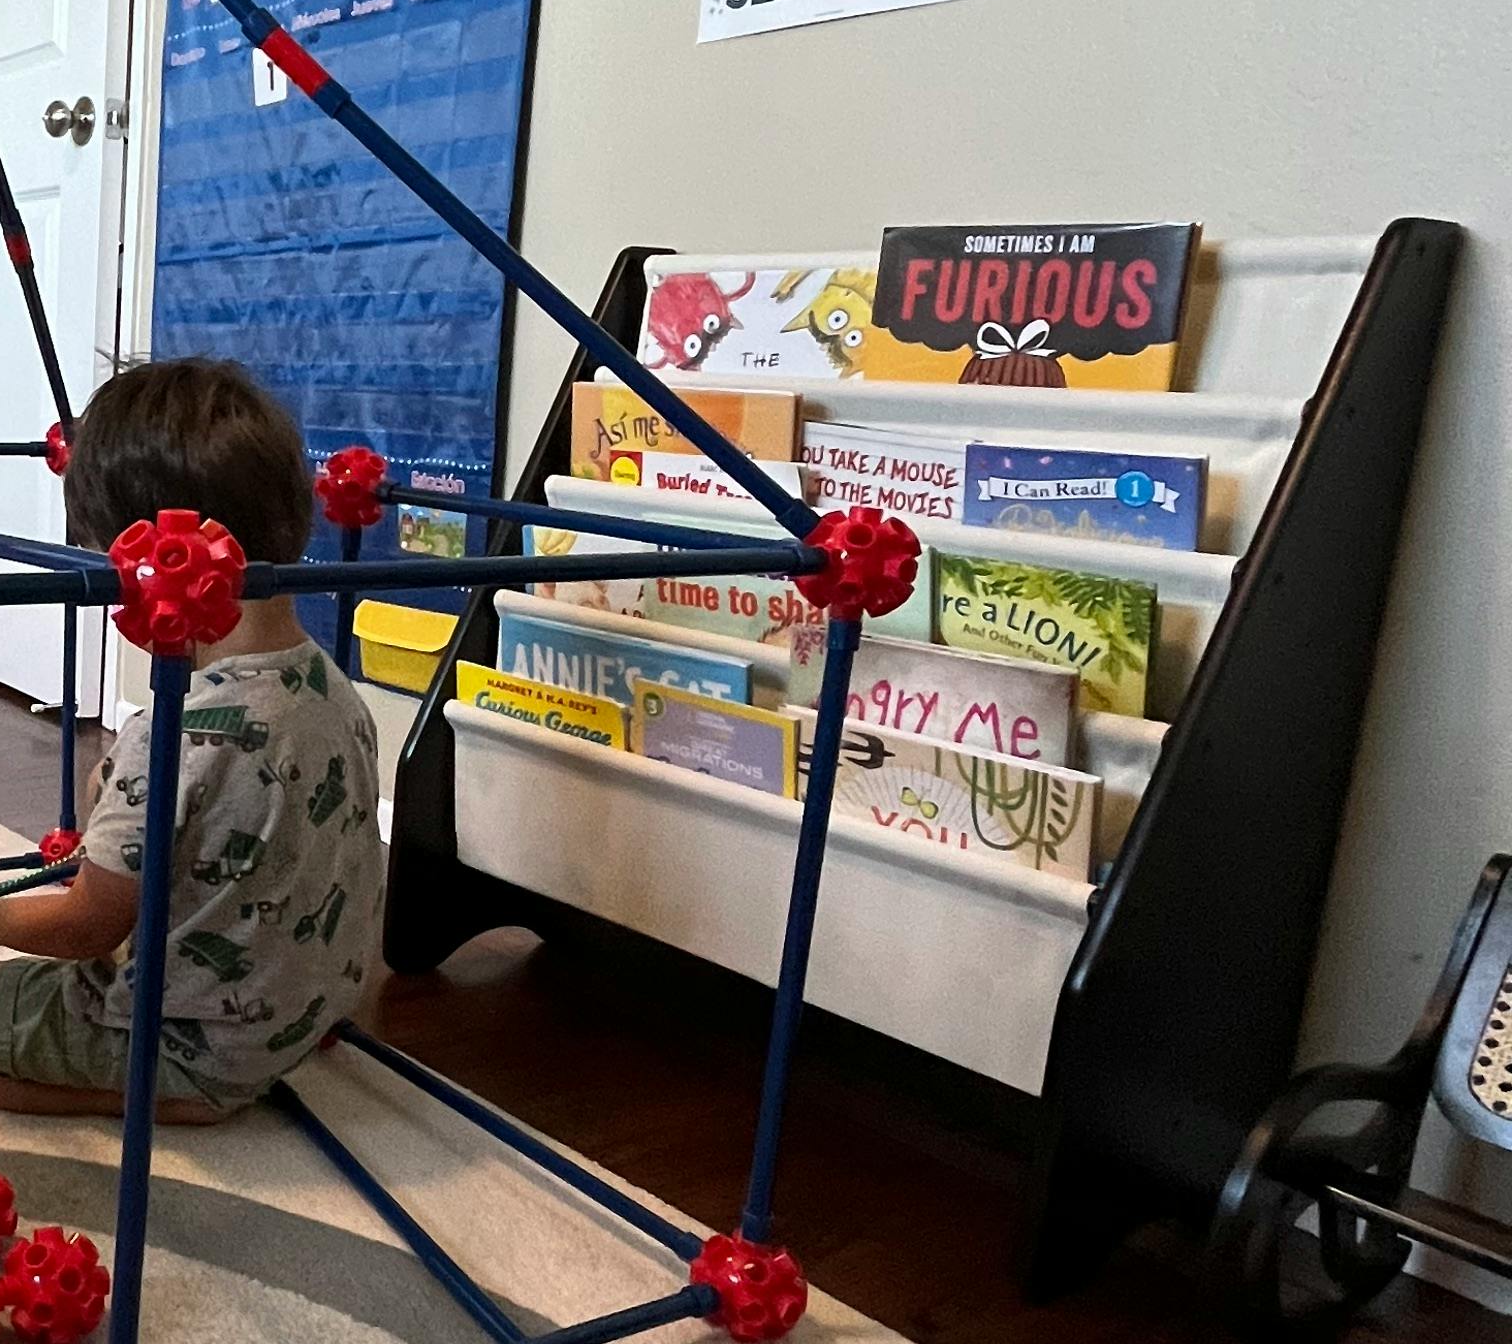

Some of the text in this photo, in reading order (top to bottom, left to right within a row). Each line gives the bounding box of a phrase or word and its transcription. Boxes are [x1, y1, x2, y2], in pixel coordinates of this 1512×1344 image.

[267, 61, 275, 91] 1
[964, 234, 1096, 254] SOMETIMES I AM
[900, 259, 1158, 330] FURIOUS
[742, 352, 781, 368] THE
[590, 411, 629, 460] Así
[633, 415, 660, 448] me
[656, 472, 712, 495] Buried
[801, 444, 960, 490] OU TAKE A MOUSE
[814, 476, 955, 520] TO THE MOVIES
[1003, 481, 1107, 498] I Can Read!
[1130, 480, 1139, 498] 1
[655, 576, 721, 611] time
[728, 585, 758, 617] to
[767, 589, 824, 624] sha
[942, 594, 1103, 667] re a LION!
[963, 622, 987, 638] And
[988, 630, 1024, 649] Other
[475, 690, 613, 747] Curious George
[646, 698, 659, 715] 3
[845, 678, 1041, 760] ngry Me
[660, 741, 765, 781] MIGRATIONS
